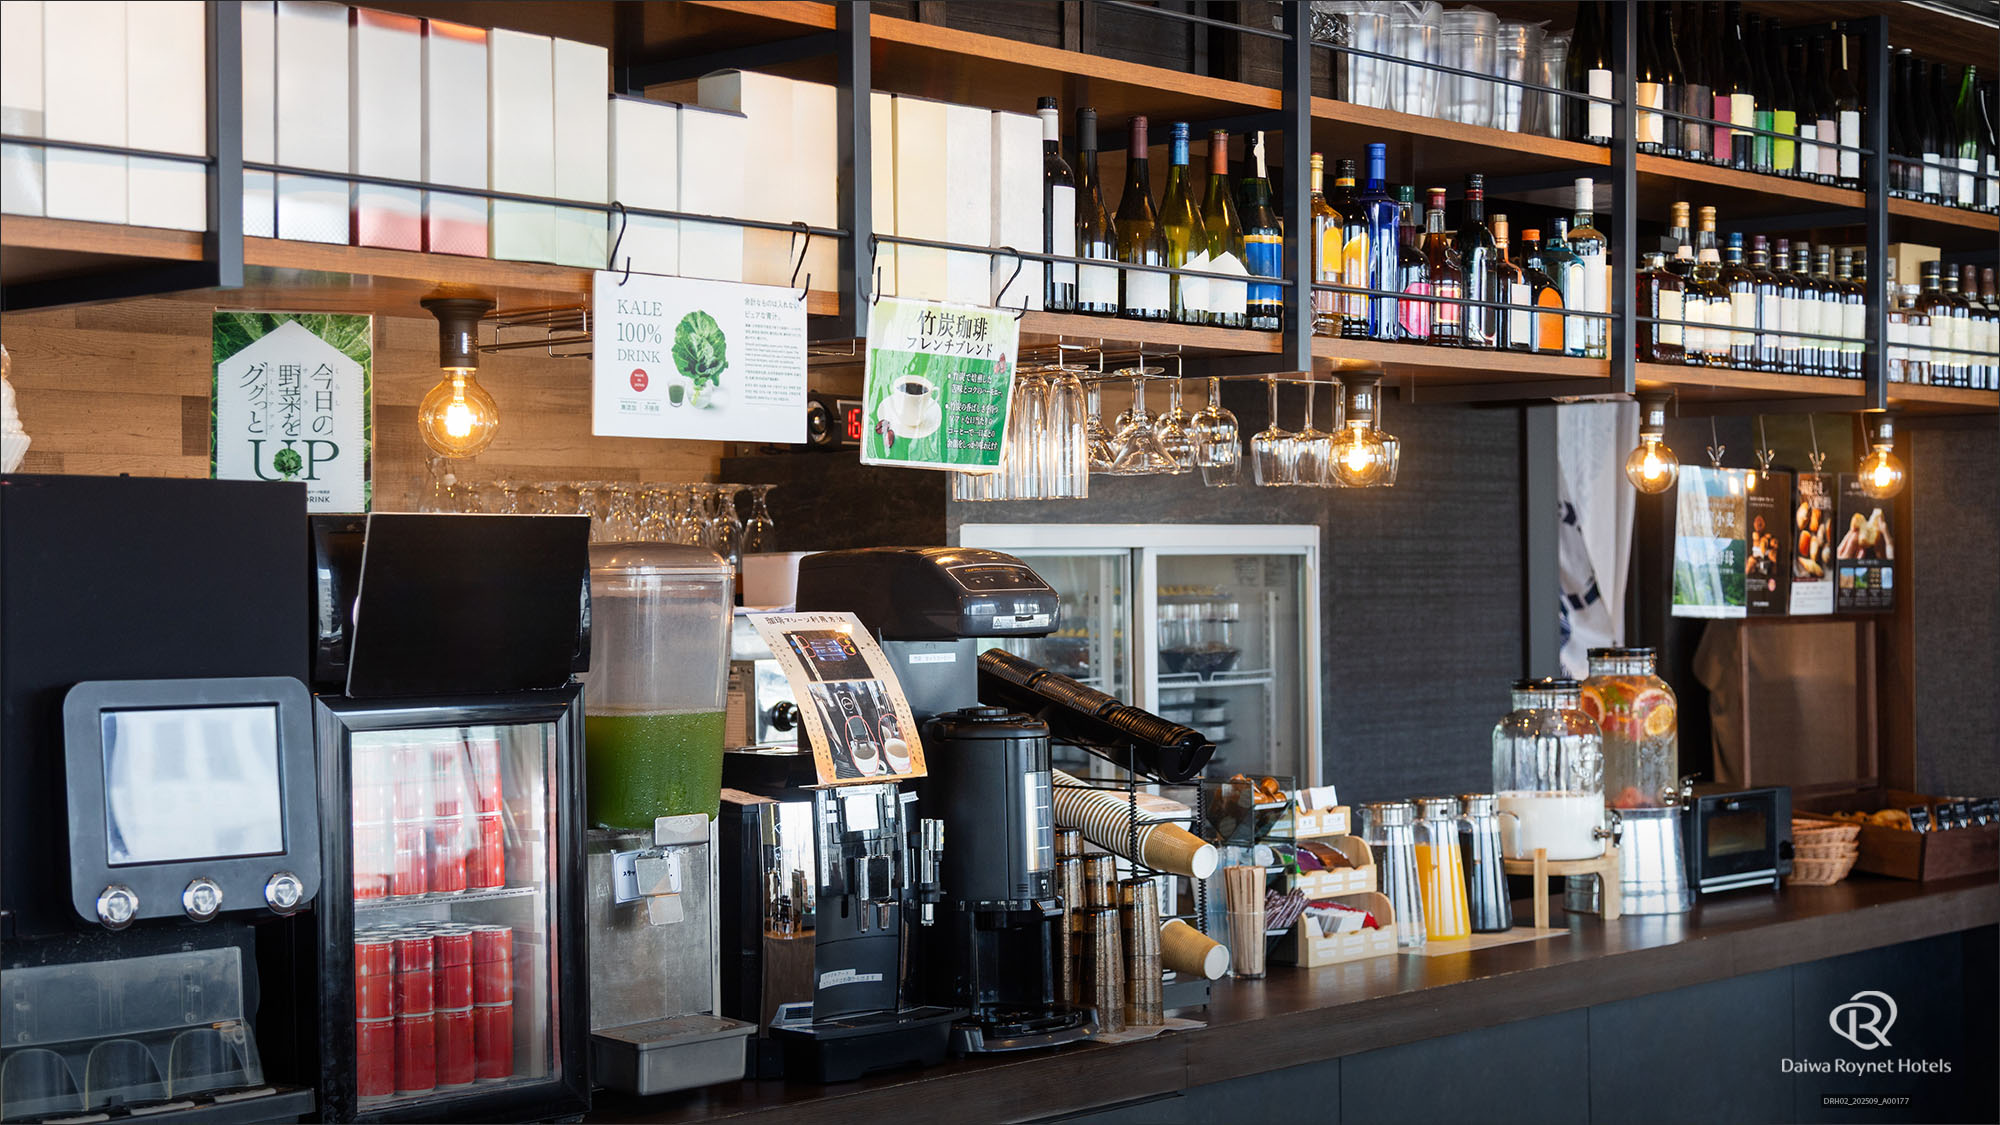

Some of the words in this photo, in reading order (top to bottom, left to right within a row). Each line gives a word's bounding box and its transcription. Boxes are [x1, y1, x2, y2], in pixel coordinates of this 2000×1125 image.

[617, 299, 662, 317] KALE
[617, 322, 662, 344] 100%
[917, 310, 989, 341] 竹炭珈琲
[617, 348, 661, 363] DRINK
[907, 337, 993, 357] フレンチブレンド
[278, 364, 301, 437] 野菜を
[310, 363, 333, 436] 今日の
[848, 408, 861, 439] 16
[247, 439, 340, 482] UP
